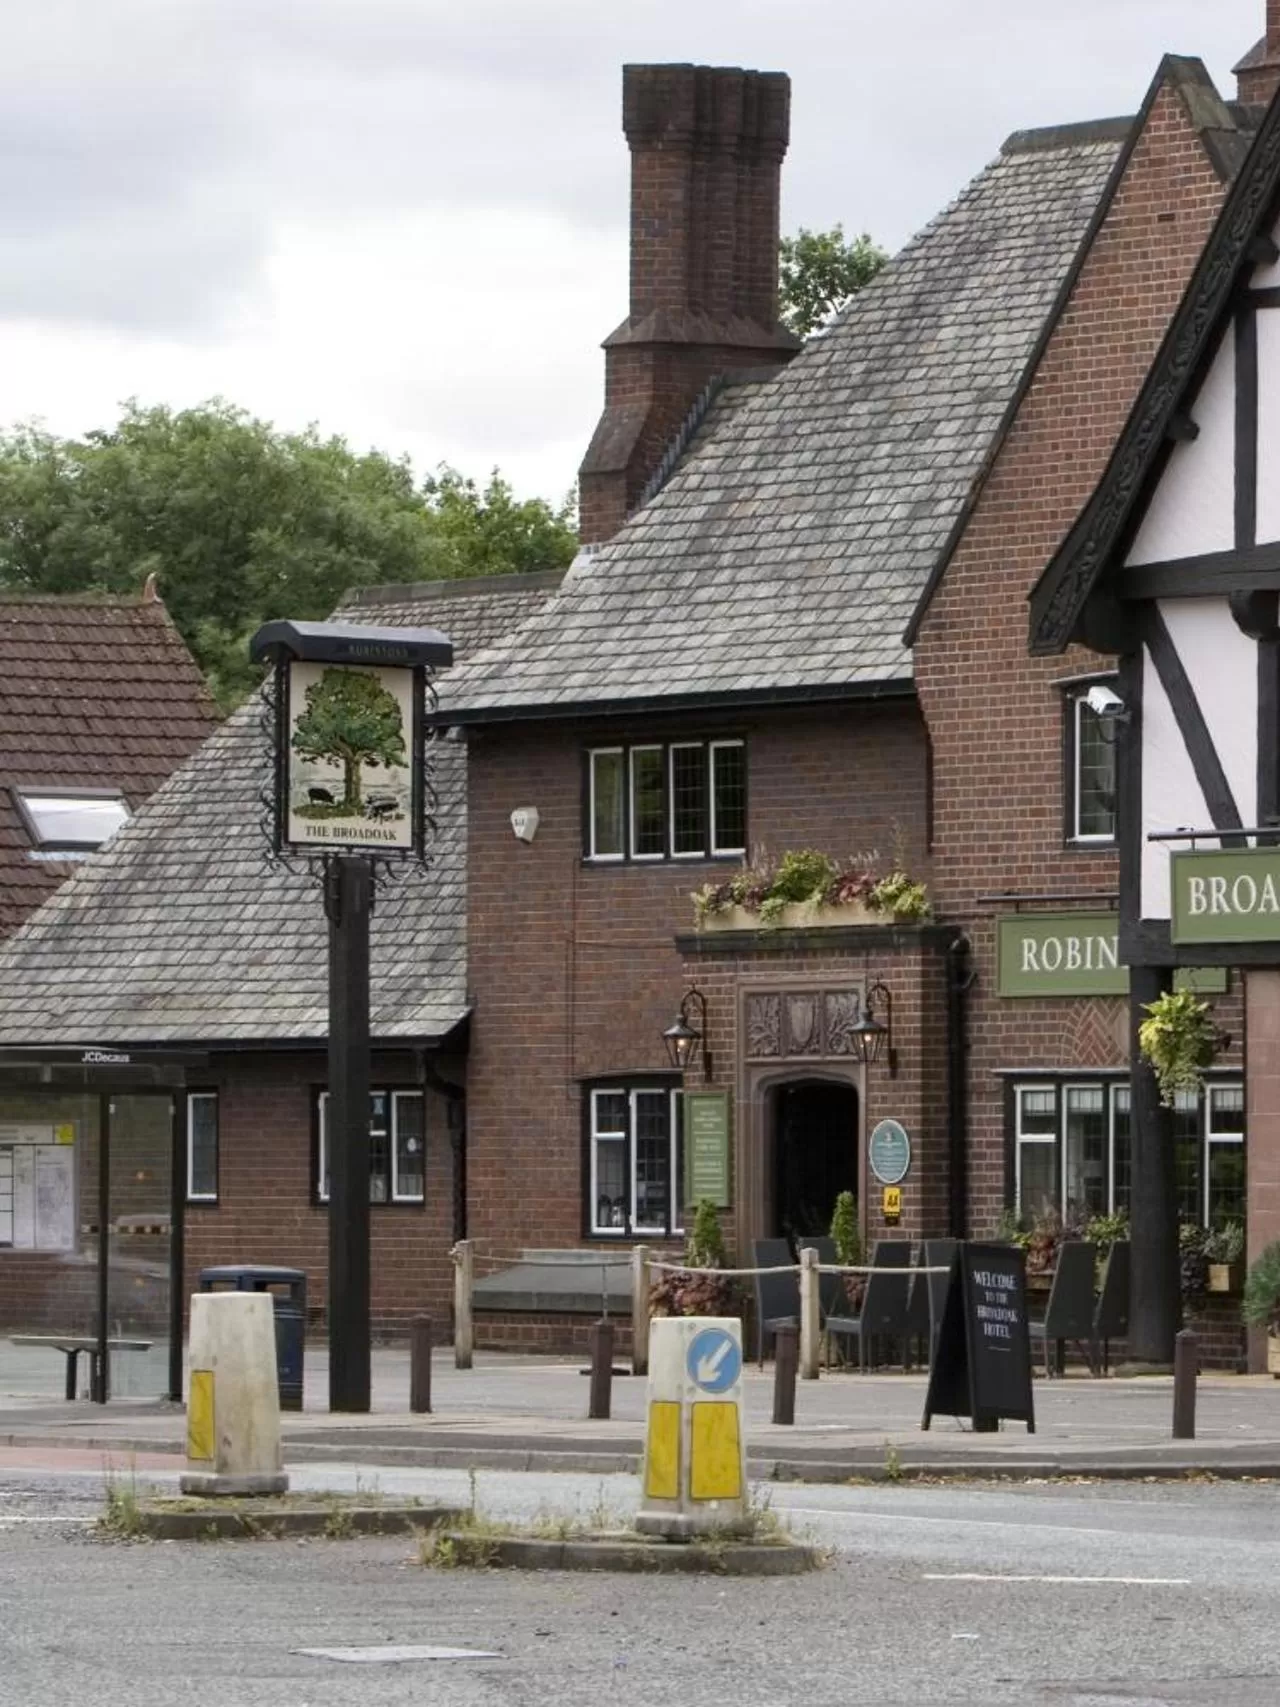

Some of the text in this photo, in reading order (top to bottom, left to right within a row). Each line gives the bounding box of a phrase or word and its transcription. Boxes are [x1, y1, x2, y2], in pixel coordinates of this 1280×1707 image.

[305, 825, 397, 841] THE BROADOAK
[1020, 935, 1120, 972] ROBIN
[973, 1269, 1017, 1290] WELCOME
[983, 1322, 1010, 1338] HOTEL
